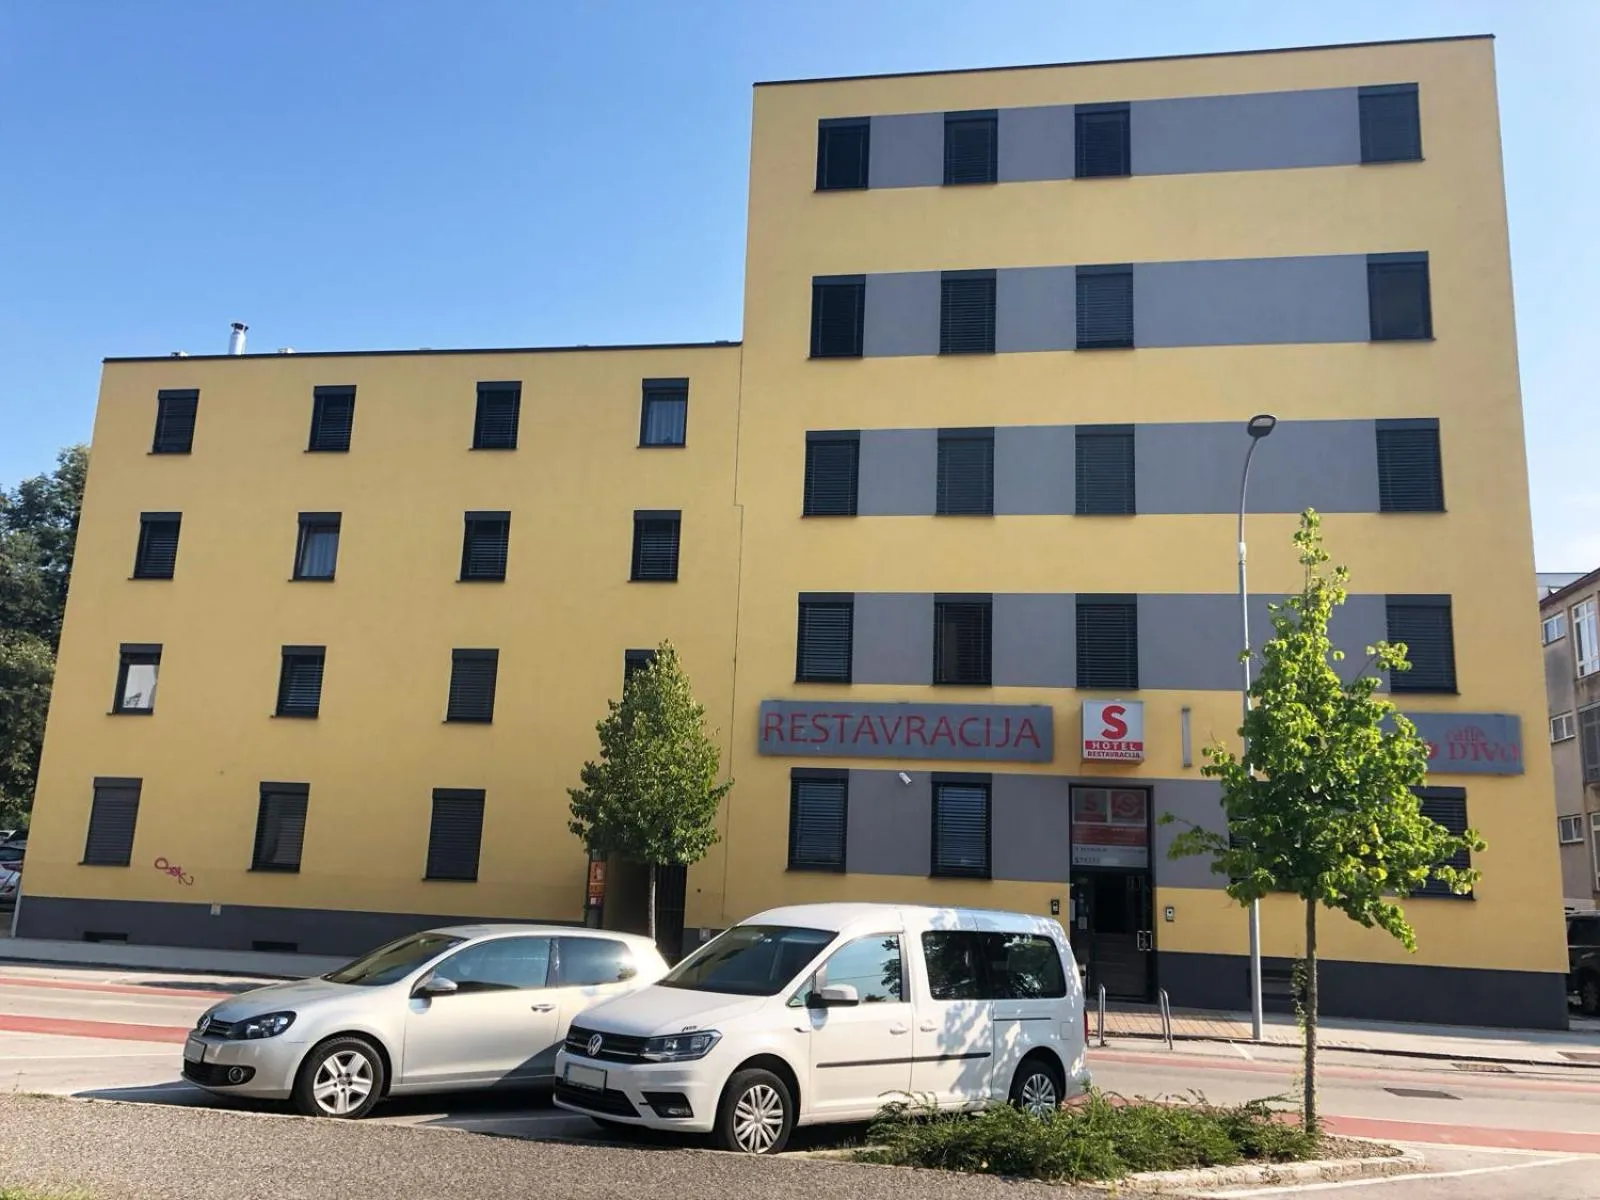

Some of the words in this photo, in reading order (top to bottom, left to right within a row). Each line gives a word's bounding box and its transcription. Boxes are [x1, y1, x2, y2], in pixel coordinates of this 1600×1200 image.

[763, 712, 1041, 748] RESTAVRACIJA
[1101, 704, 1128, 740] S
[1091, 742, 1136, 751] HOTEL
